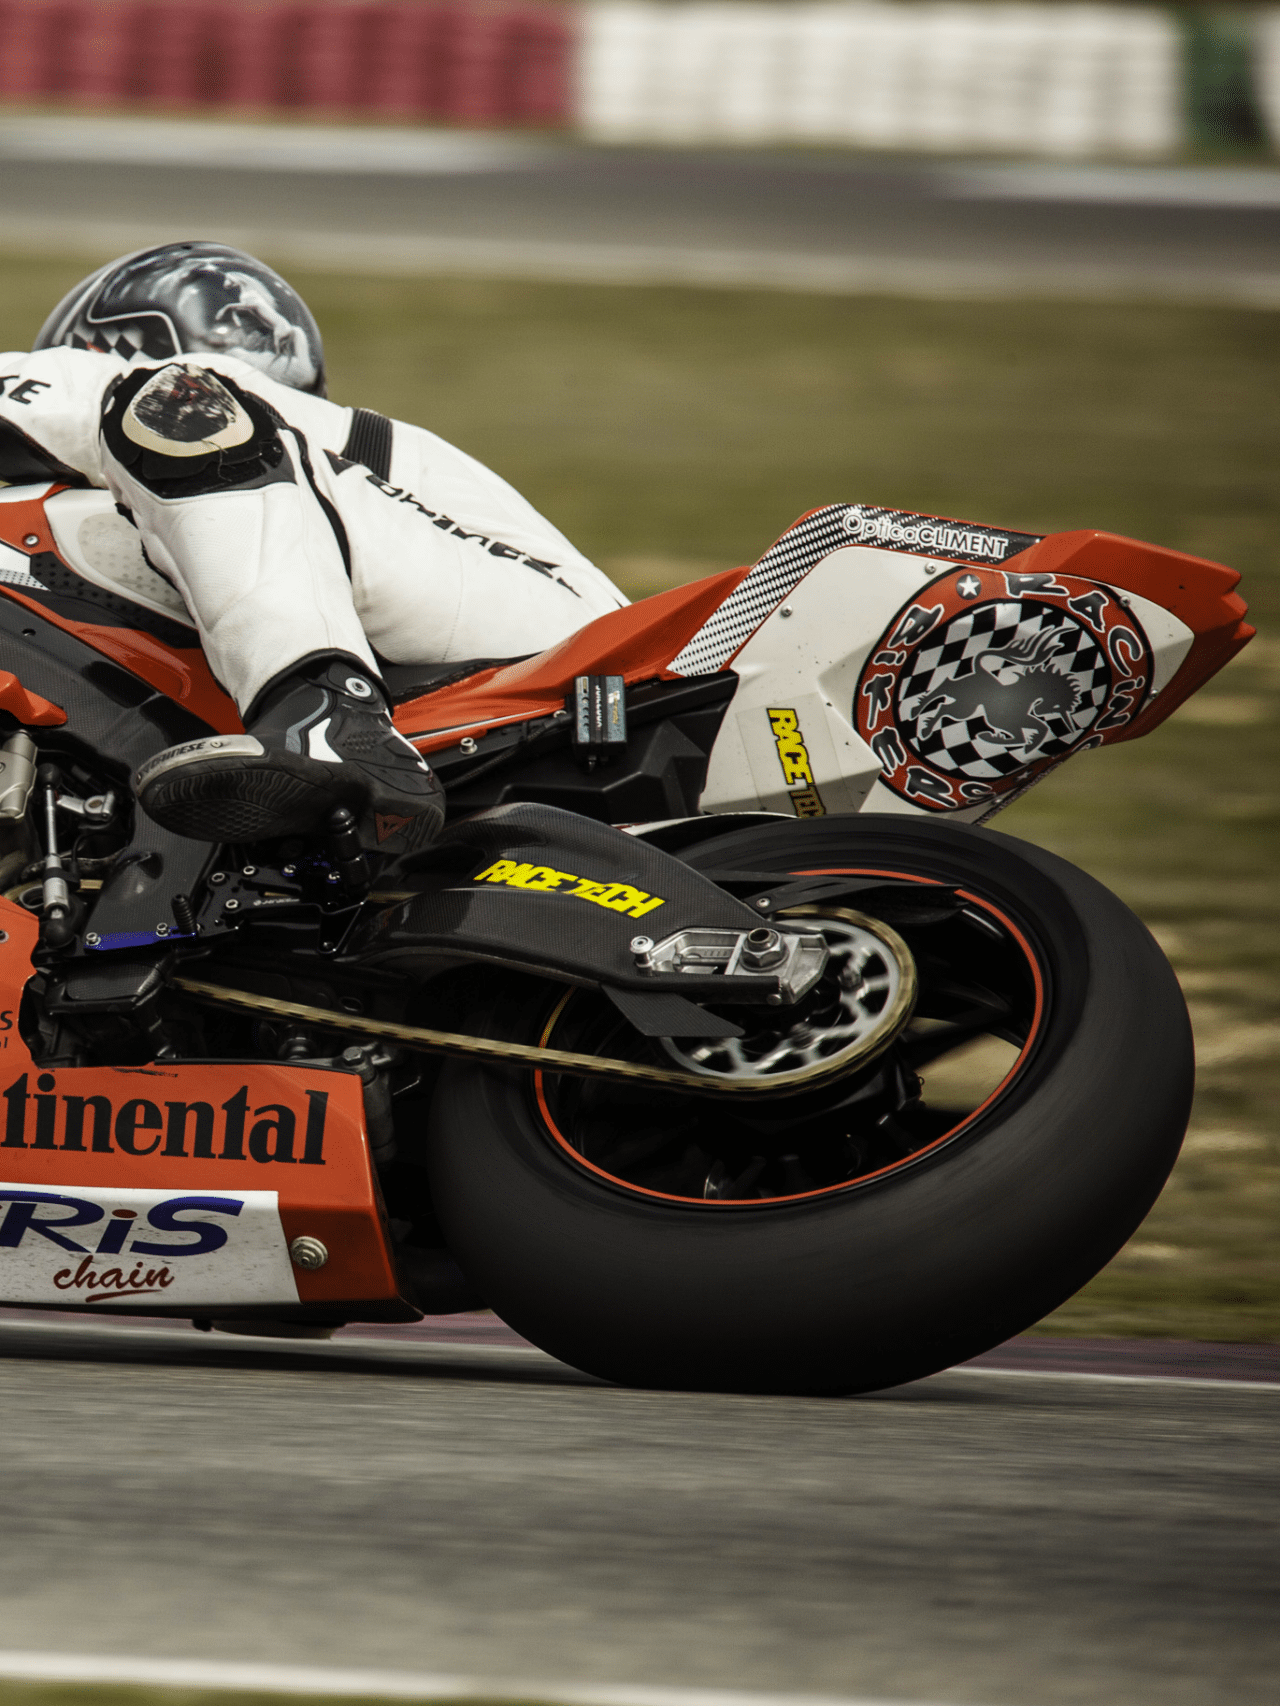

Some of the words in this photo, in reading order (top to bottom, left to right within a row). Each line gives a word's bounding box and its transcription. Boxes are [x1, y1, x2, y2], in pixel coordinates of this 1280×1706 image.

[766, 708, 815, 786] RACE
[473, 859, 578, 892] RACE
[562, 878, 665, 918] TECH
[53, 1254, 175, 1290] chain
